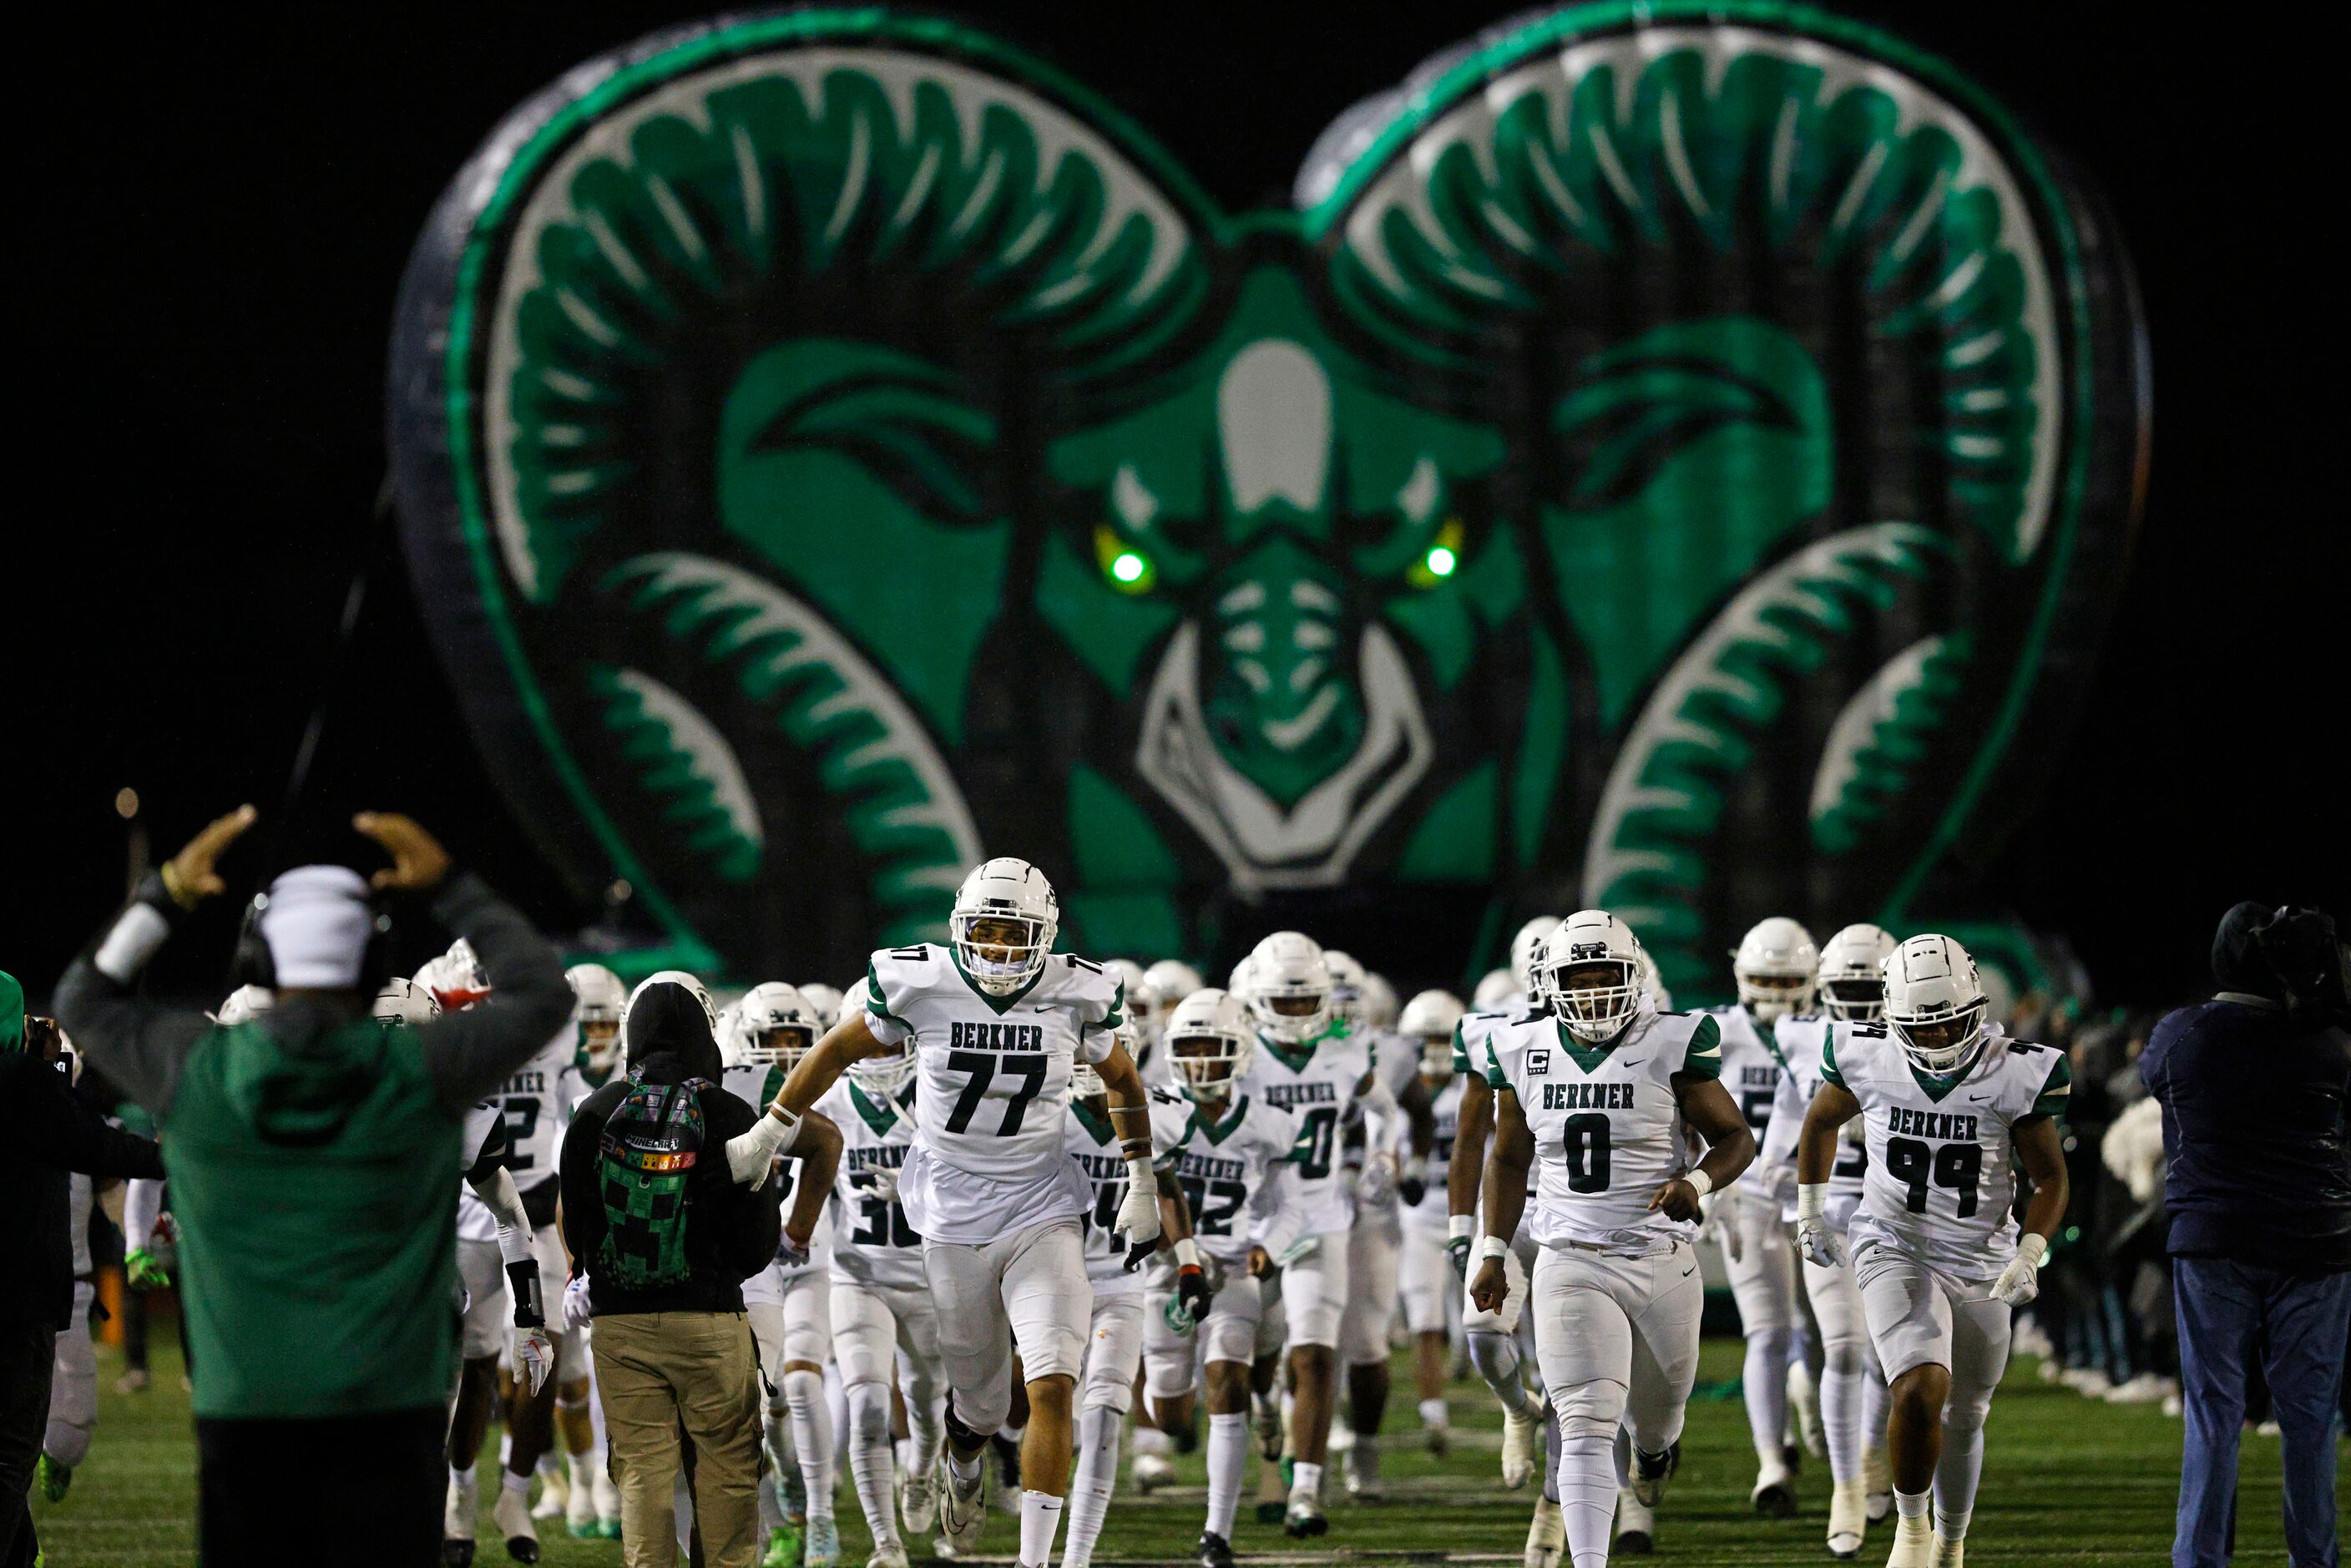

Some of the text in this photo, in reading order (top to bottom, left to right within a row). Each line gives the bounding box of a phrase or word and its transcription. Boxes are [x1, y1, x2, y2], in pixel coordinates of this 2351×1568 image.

[951, 1022, 1043, 1052] BERKNER
[1529, 1051, 1550, 1069] C
[944, 1051, 1048, 1137] 77
[1543, 1083, 1634, 1110] BERKNER
[1888, 1106, 1978, 1141] BERKNER
[1563, 1113, 1611, 1194] 0
[1886, 1136, 1984, 1219] 99
